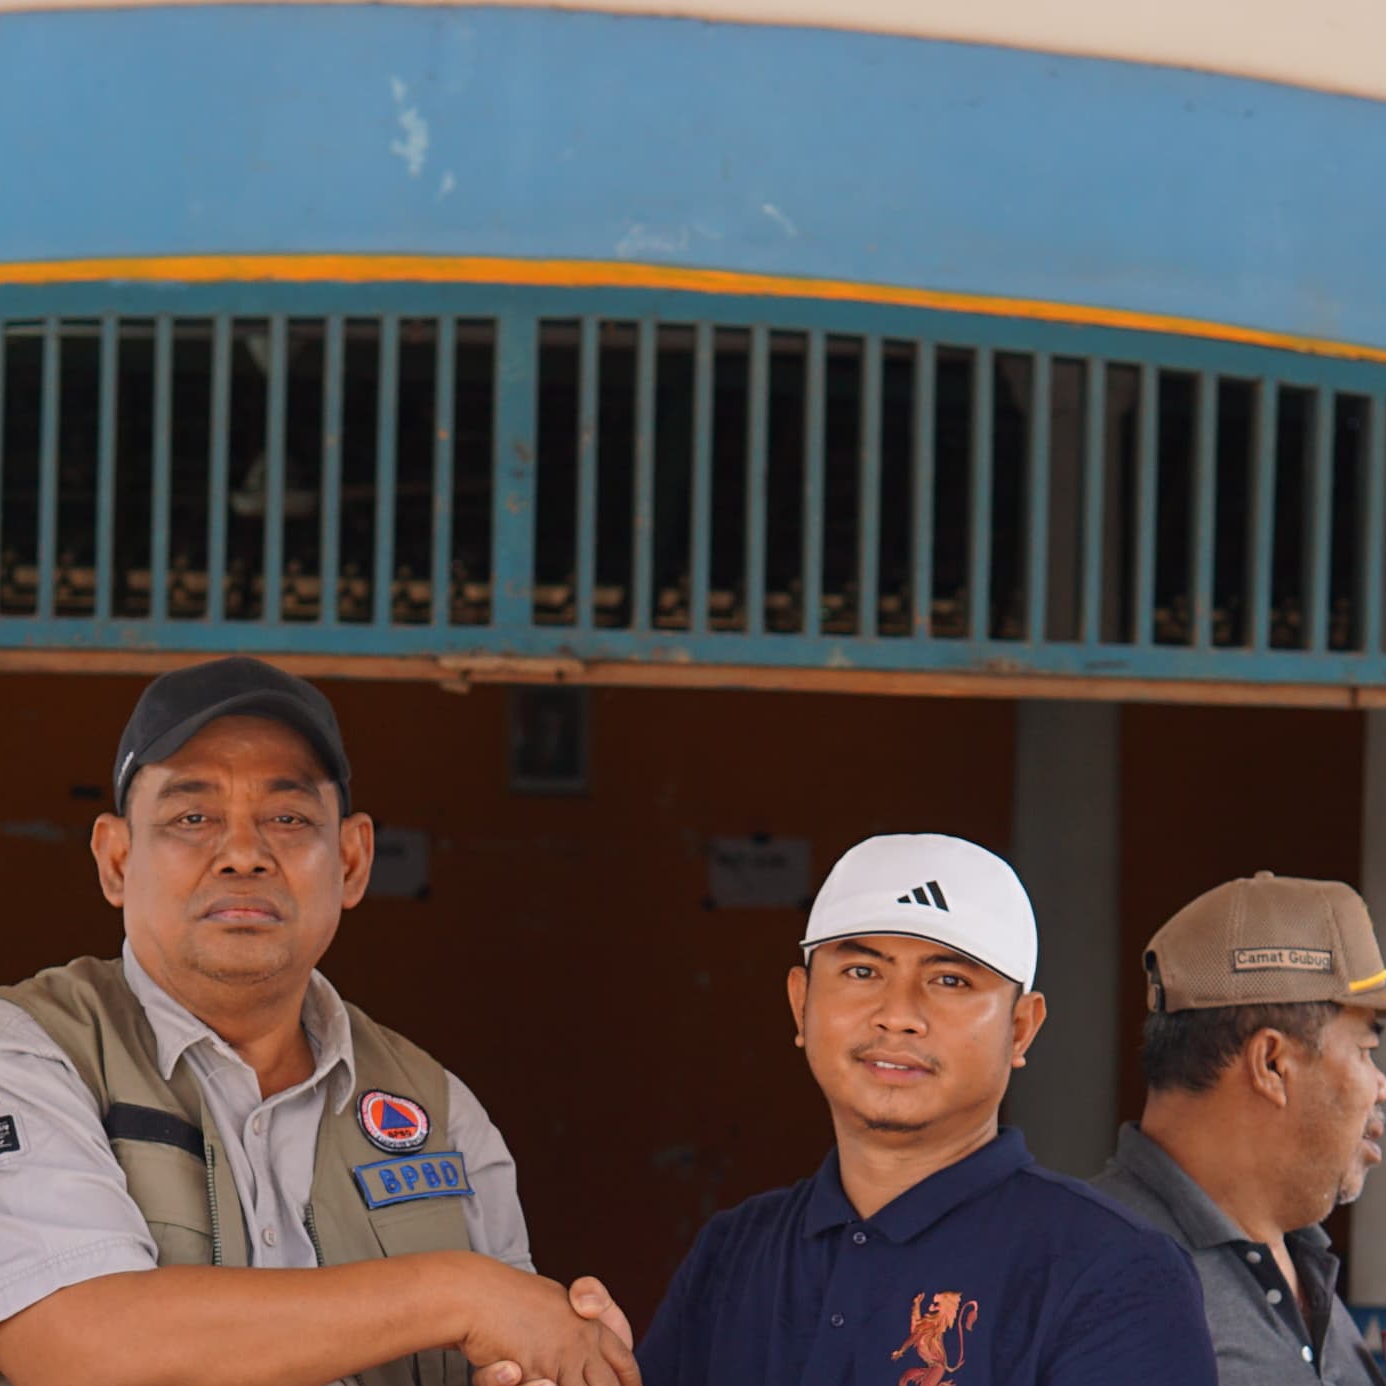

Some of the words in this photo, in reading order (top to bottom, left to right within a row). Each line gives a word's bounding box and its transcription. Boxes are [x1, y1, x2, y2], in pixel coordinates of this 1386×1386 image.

[1237, 952, 1284, 965] Camat
[1289, 952, 1331, 967] Gubug
[379, 1161, 459, 1194] BPBD
